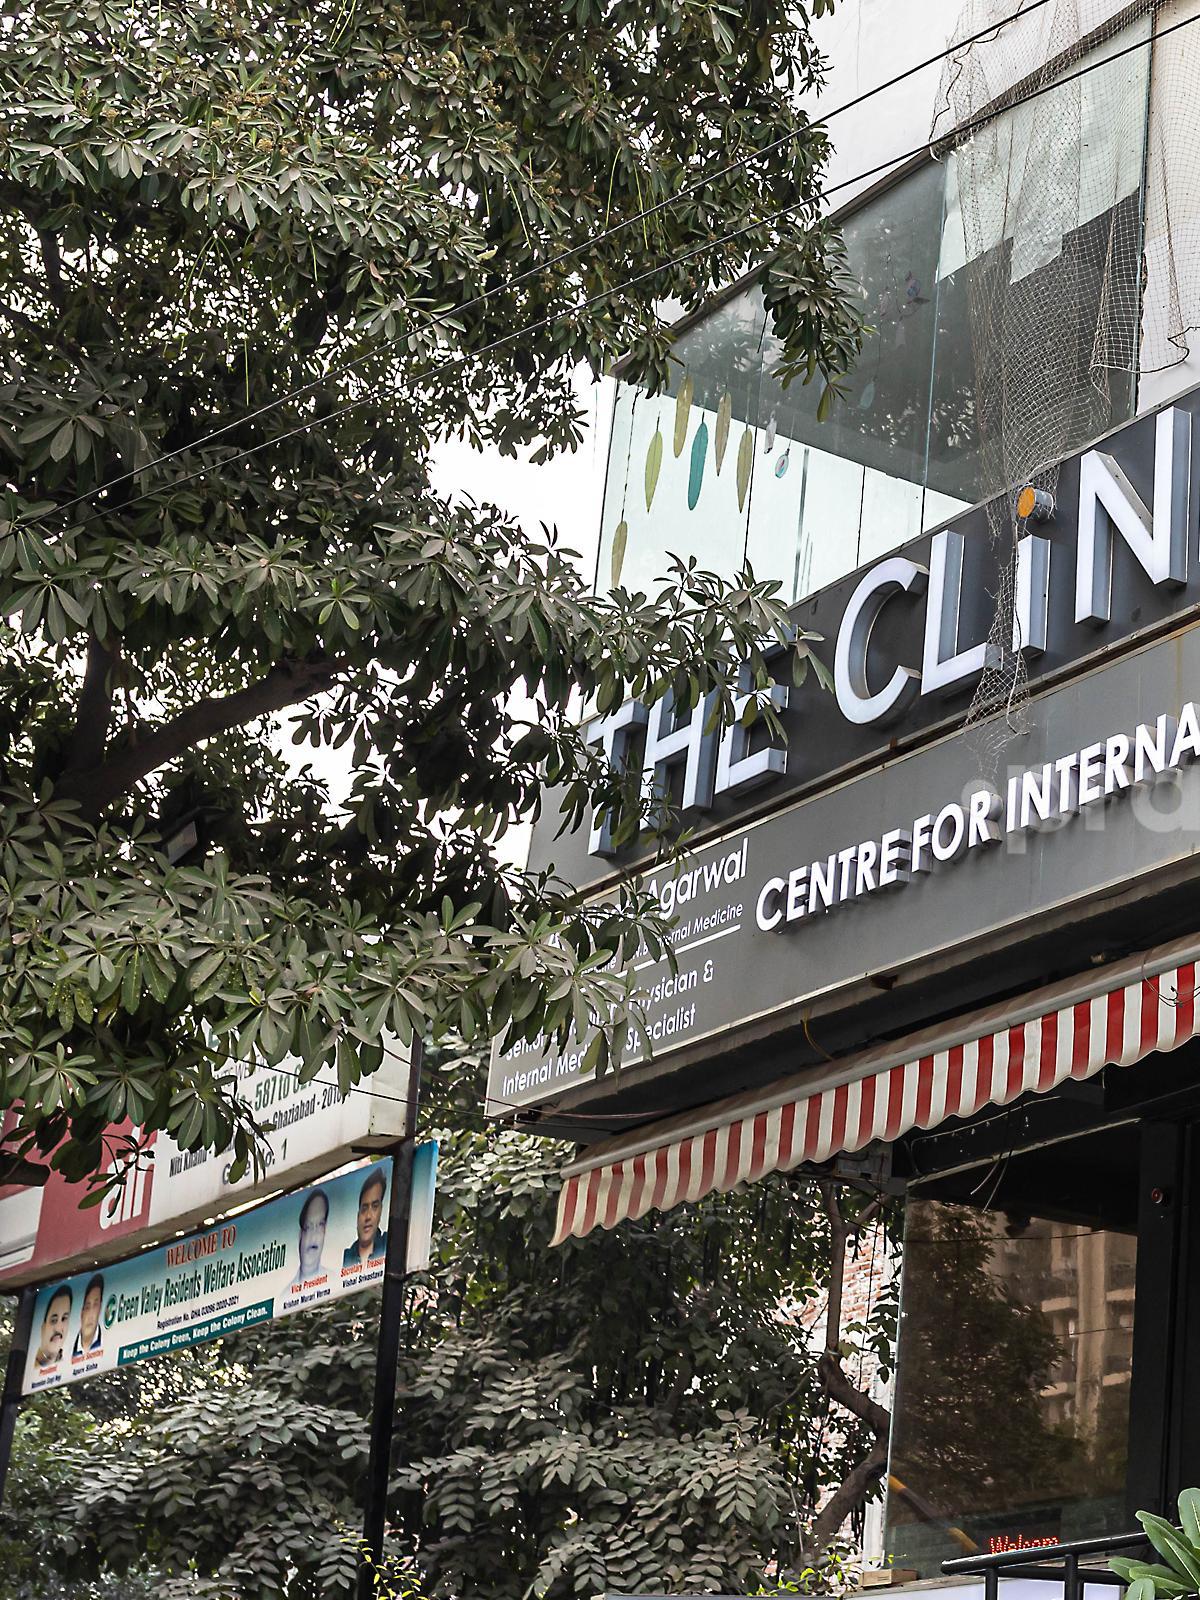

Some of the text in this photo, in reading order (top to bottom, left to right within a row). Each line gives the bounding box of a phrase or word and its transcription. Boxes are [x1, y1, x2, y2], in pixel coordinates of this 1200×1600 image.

[585, 628, 793, 856] THE
[648, 837, 749, 921] Agarwal
[754, 828, 910, 932] CENTRE
[911, 788, 1000, 864] FOR
[693, 903, 743, 937] Medicine
[703, 959, 714, 983] &
[254, 1075, 277, 1112] 587
[502, 1058, 553, 1098] Internal
[272, 1094, 316, 1130] Ghaziabad
[167, 1225, 237, 1268] WELCOME TO
[117, 1294, 140, 1323] Green
[140, 1284, 164, 1317] Valley
[163, 1270, 202, 1308] Residents
[203, 1259, 235, 1295] Welfare
[236, 1239, 287, 1283] Association
[291, 1274, 328, 1294] Vice President
[340, 1263, 363, 1278] Secretary
[122, 1347, 138, 1360] Keep
[138, 1344, 150, 1354] the
[150, 1337, 171, 1351] Colony
[193, 1327, 209, 1340] Keep
[210, 1321, 221, 1333] the
[222, 1314, 246, 1328] Colony
[246, 1306, 268, 1321] Clean.
